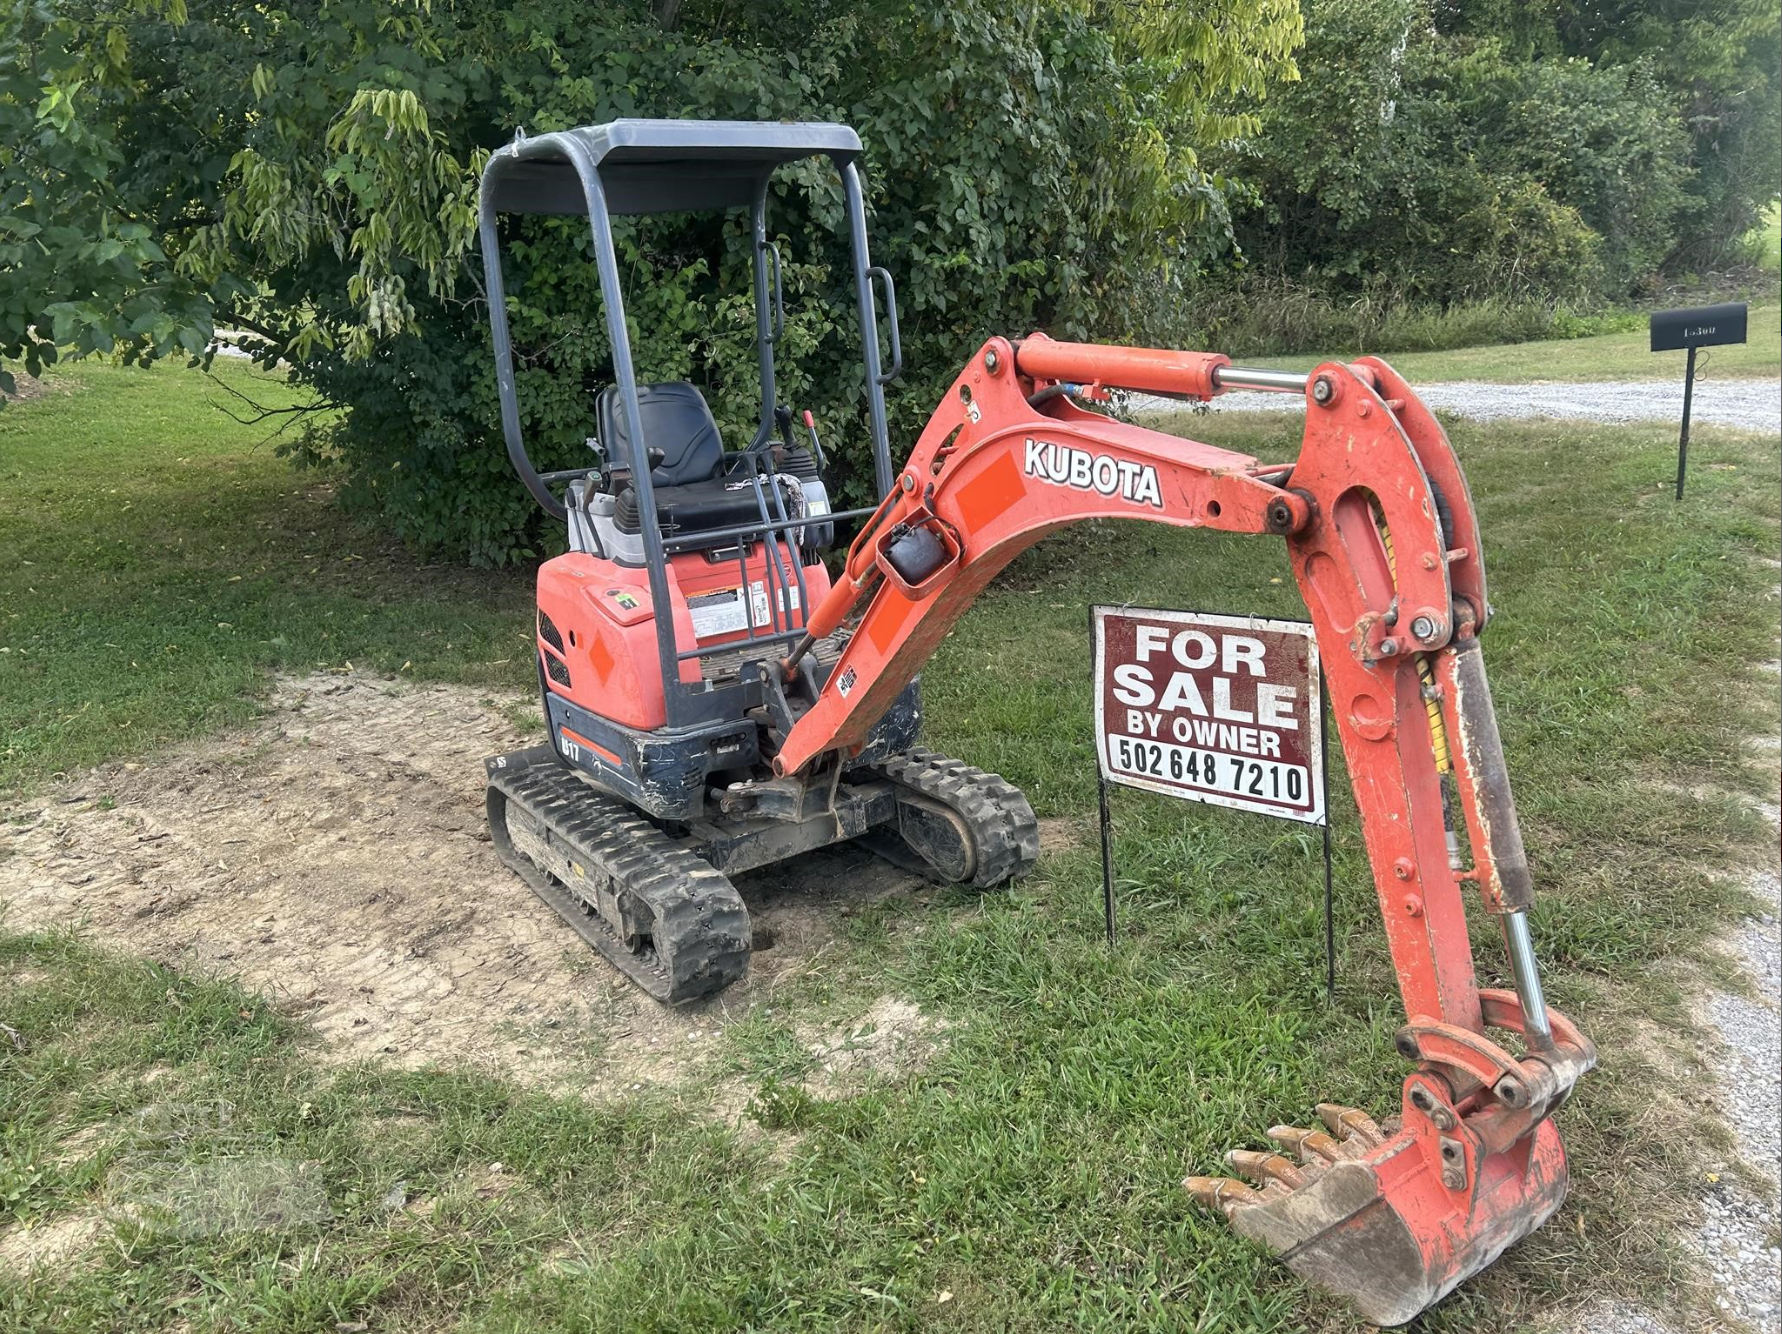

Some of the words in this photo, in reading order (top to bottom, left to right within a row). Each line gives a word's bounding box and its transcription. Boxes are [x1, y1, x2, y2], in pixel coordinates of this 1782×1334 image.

[1024, 438, 1163, 507] KUBOTA
[1136, 625, 1266, 677] FOR
[1113, 664, 1298, 730] SALE
[1127, 709, 1162, 737] BY
[1172, 717, 1281, 758] OWNER
[1120, 739, 1162, 776] 502
[1170, 749, 1216, 788] 648
[1230, 758, 1302, 801] 7210
